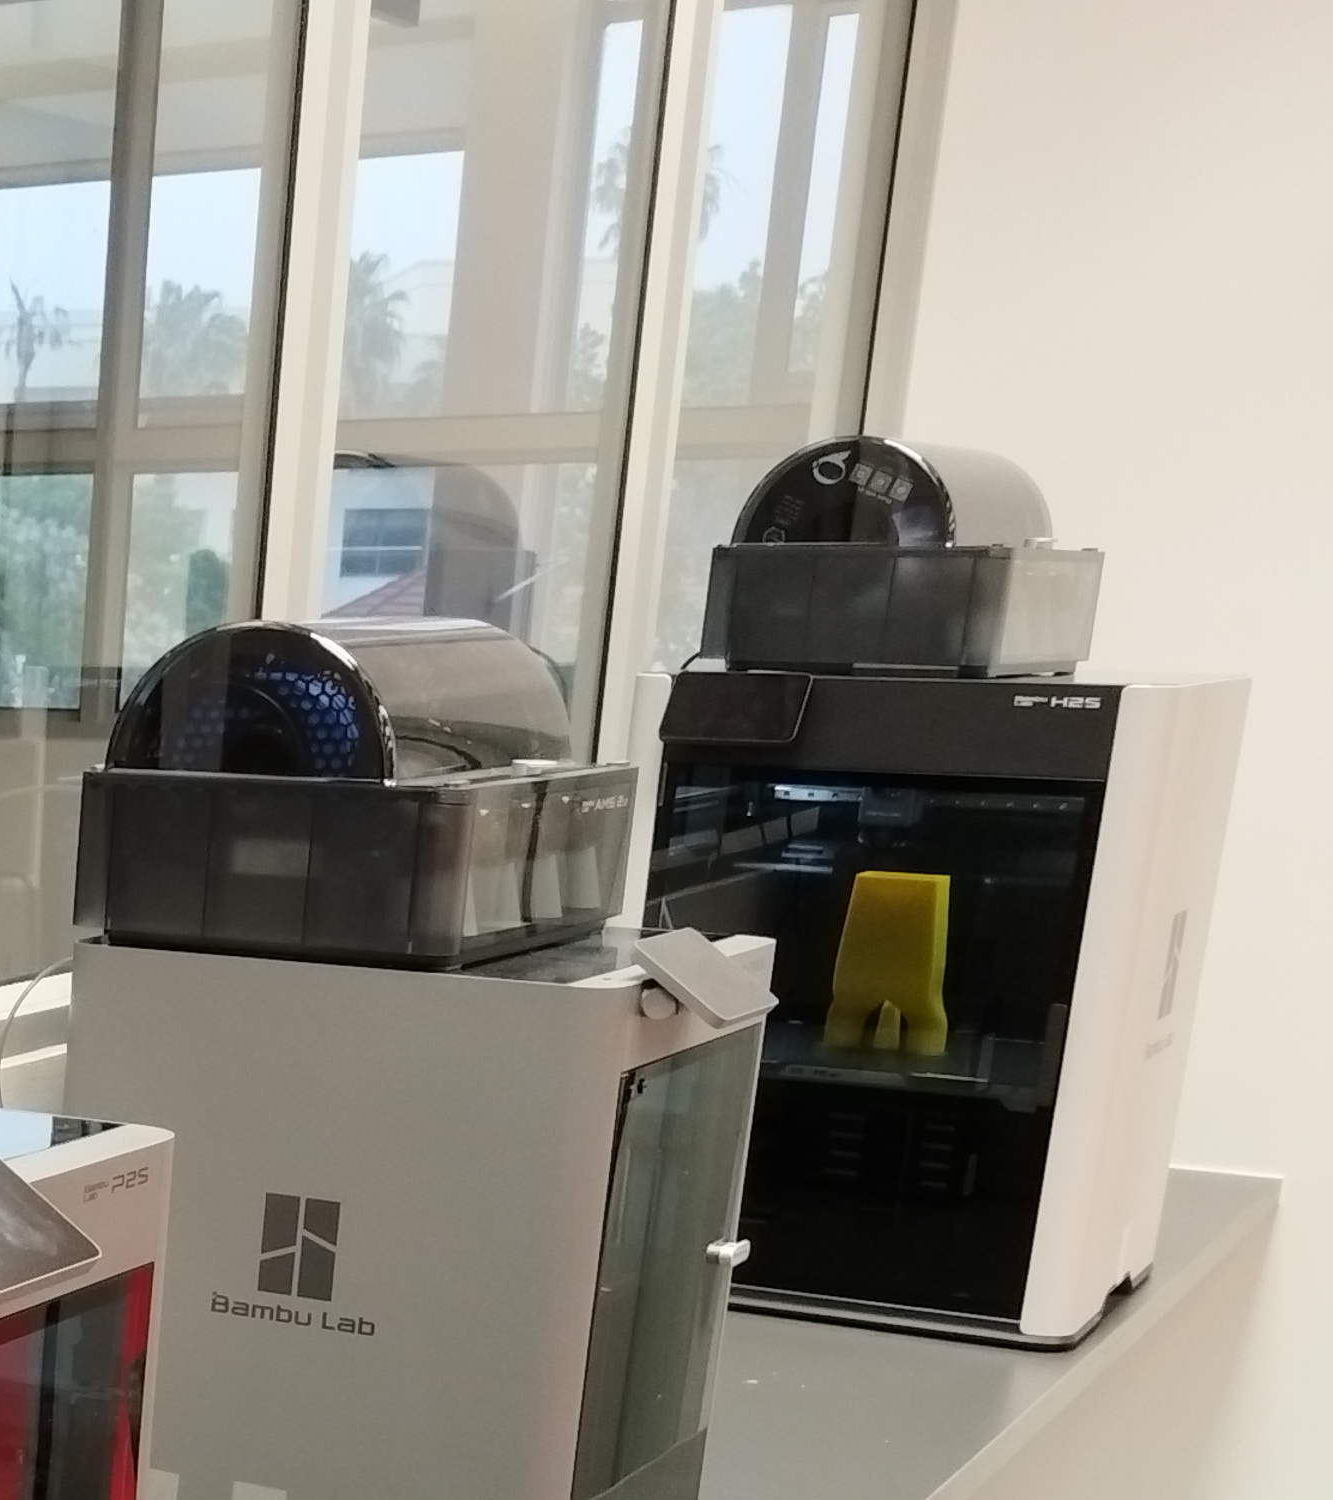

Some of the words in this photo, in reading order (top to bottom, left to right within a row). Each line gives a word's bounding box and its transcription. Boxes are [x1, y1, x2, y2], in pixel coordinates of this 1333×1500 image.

[111, 1166, 149, 1194] P2S
[210, 1291, 312, 1327] Bambu
[321, 1311, 376, 1336] Lab
